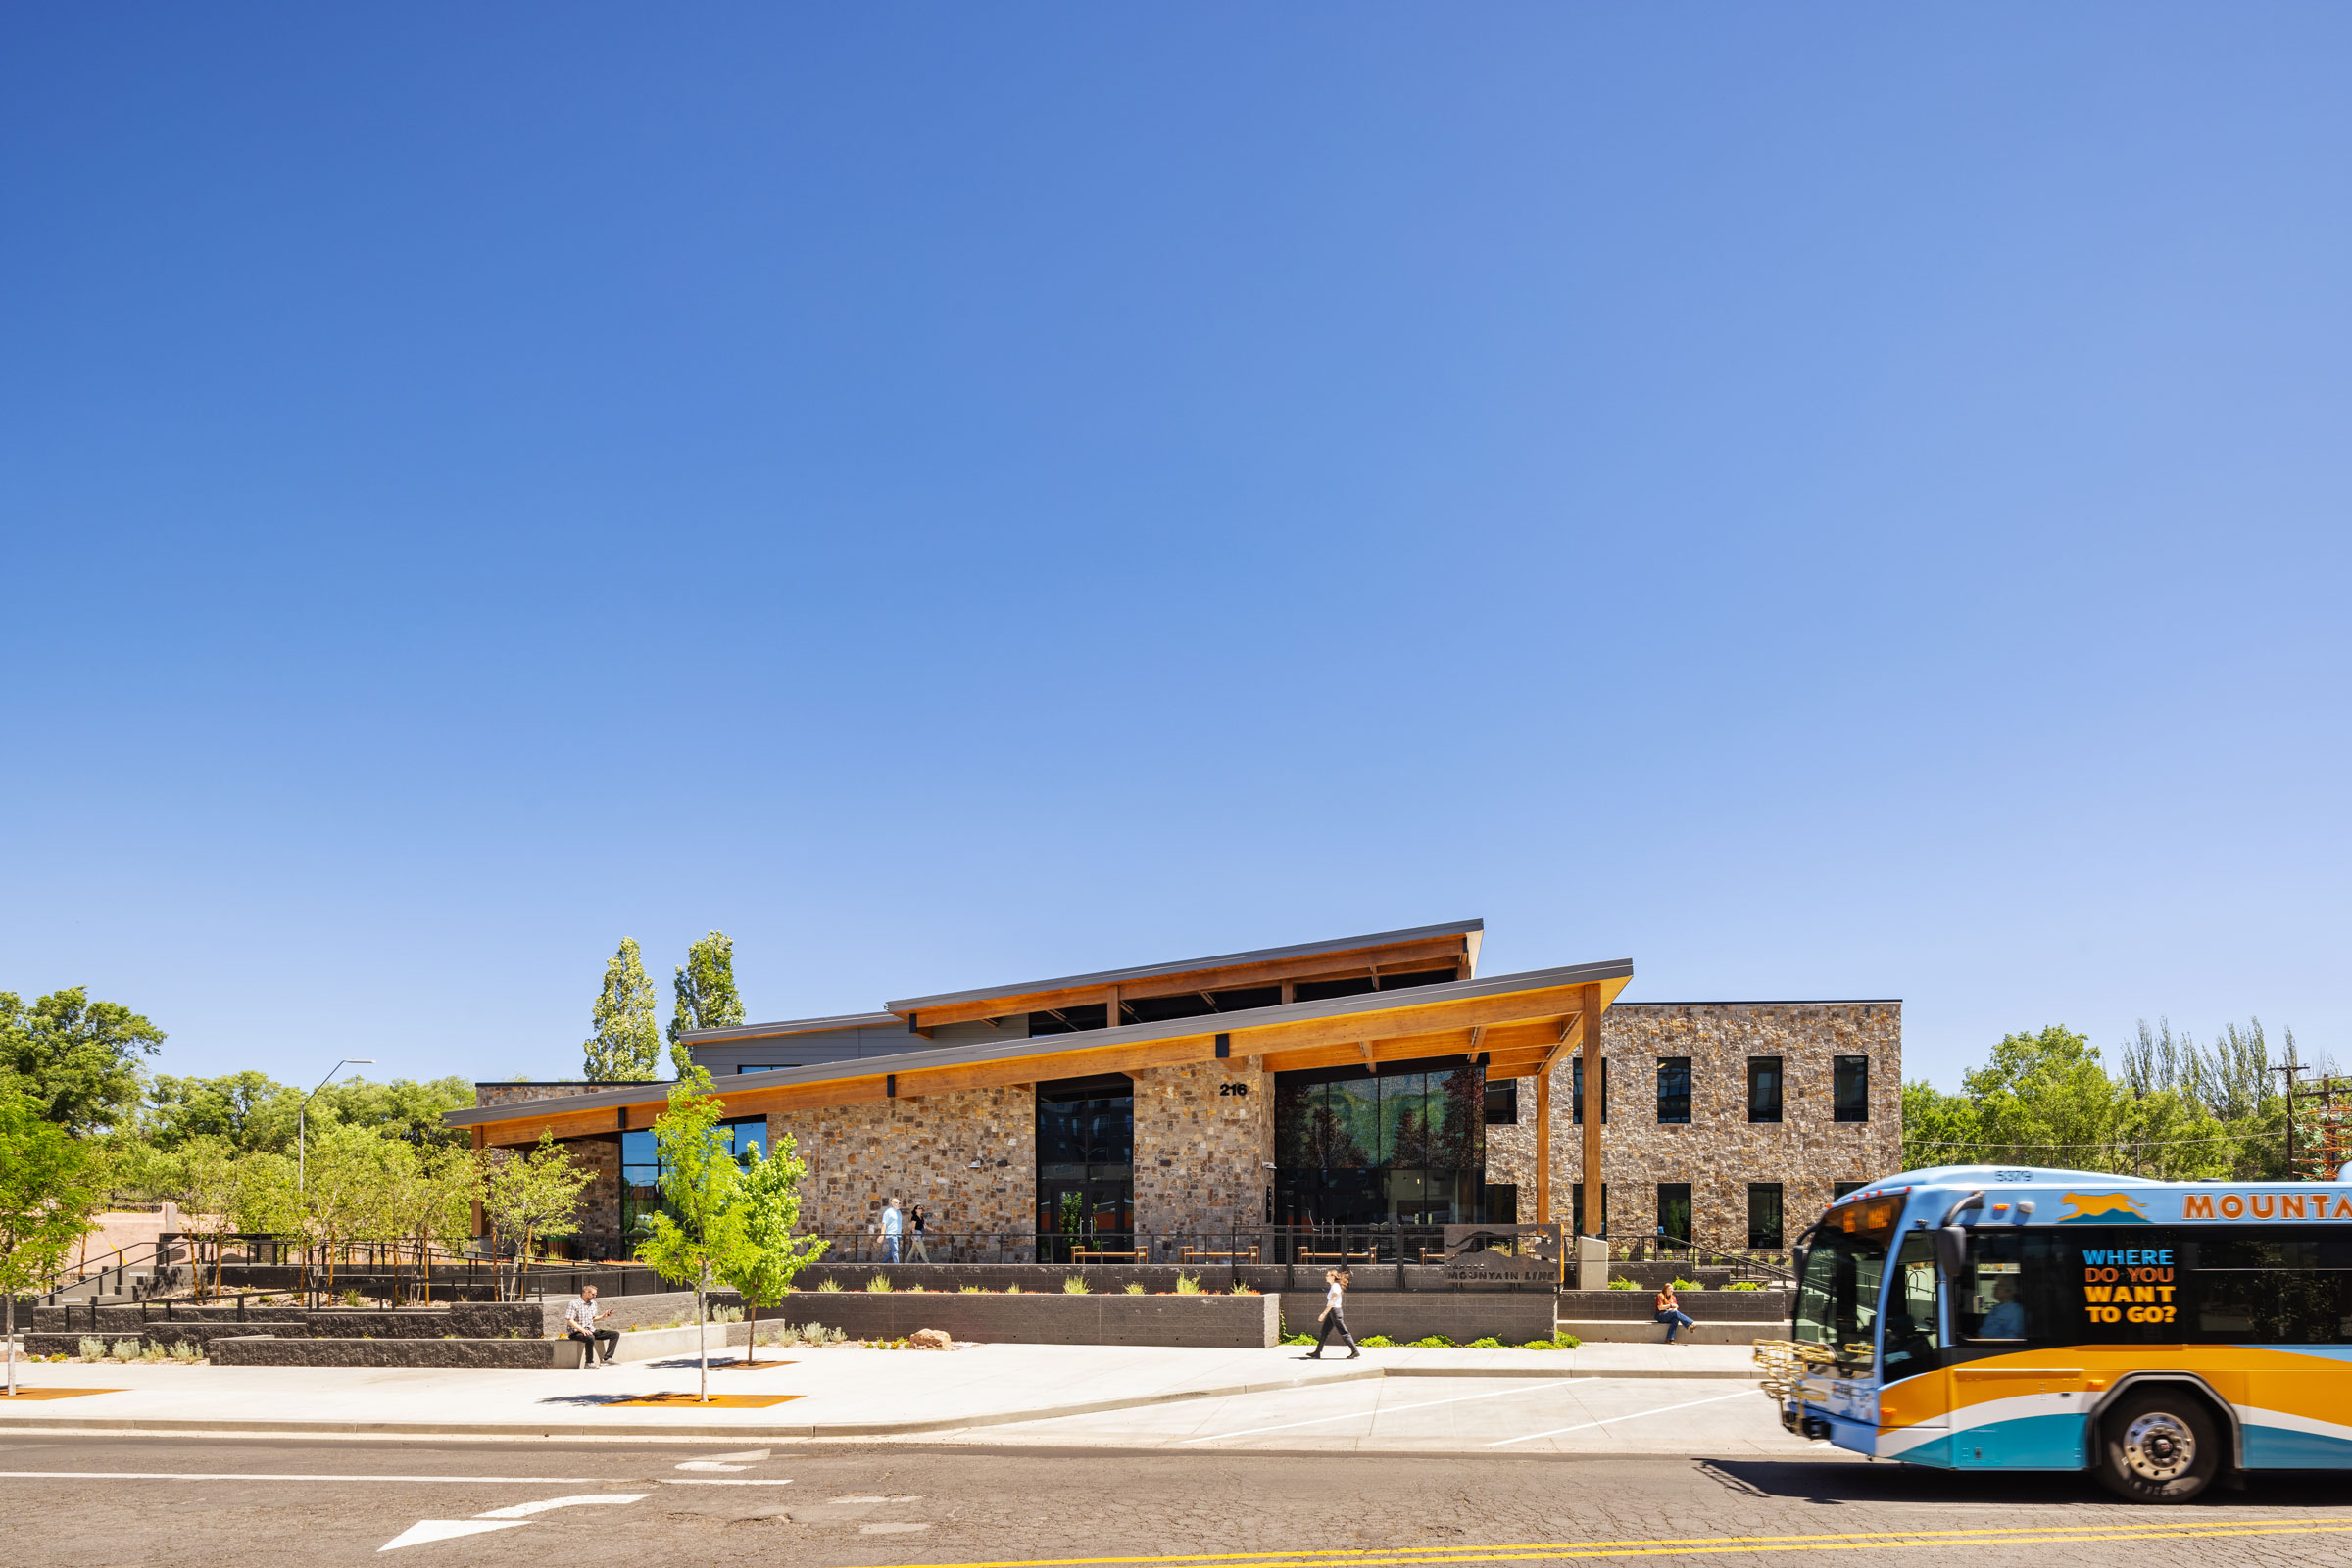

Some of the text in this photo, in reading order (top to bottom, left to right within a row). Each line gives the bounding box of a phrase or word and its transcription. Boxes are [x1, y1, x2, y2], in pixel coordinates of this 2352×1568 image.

[1220, 1084, 1247, 1096] 216
[2182, 1193, 2352, 1220] MOUNTA
[2082, 1250, 2175, 1265] WHERE
[1524, 1271, 1556, 1281] LINE
[2084, 1267, 2174, 1283] DO YOU
[2083, 1285, 2176, 1303] WANT
[2084, 1305, 2177, 1323] TO GO?
